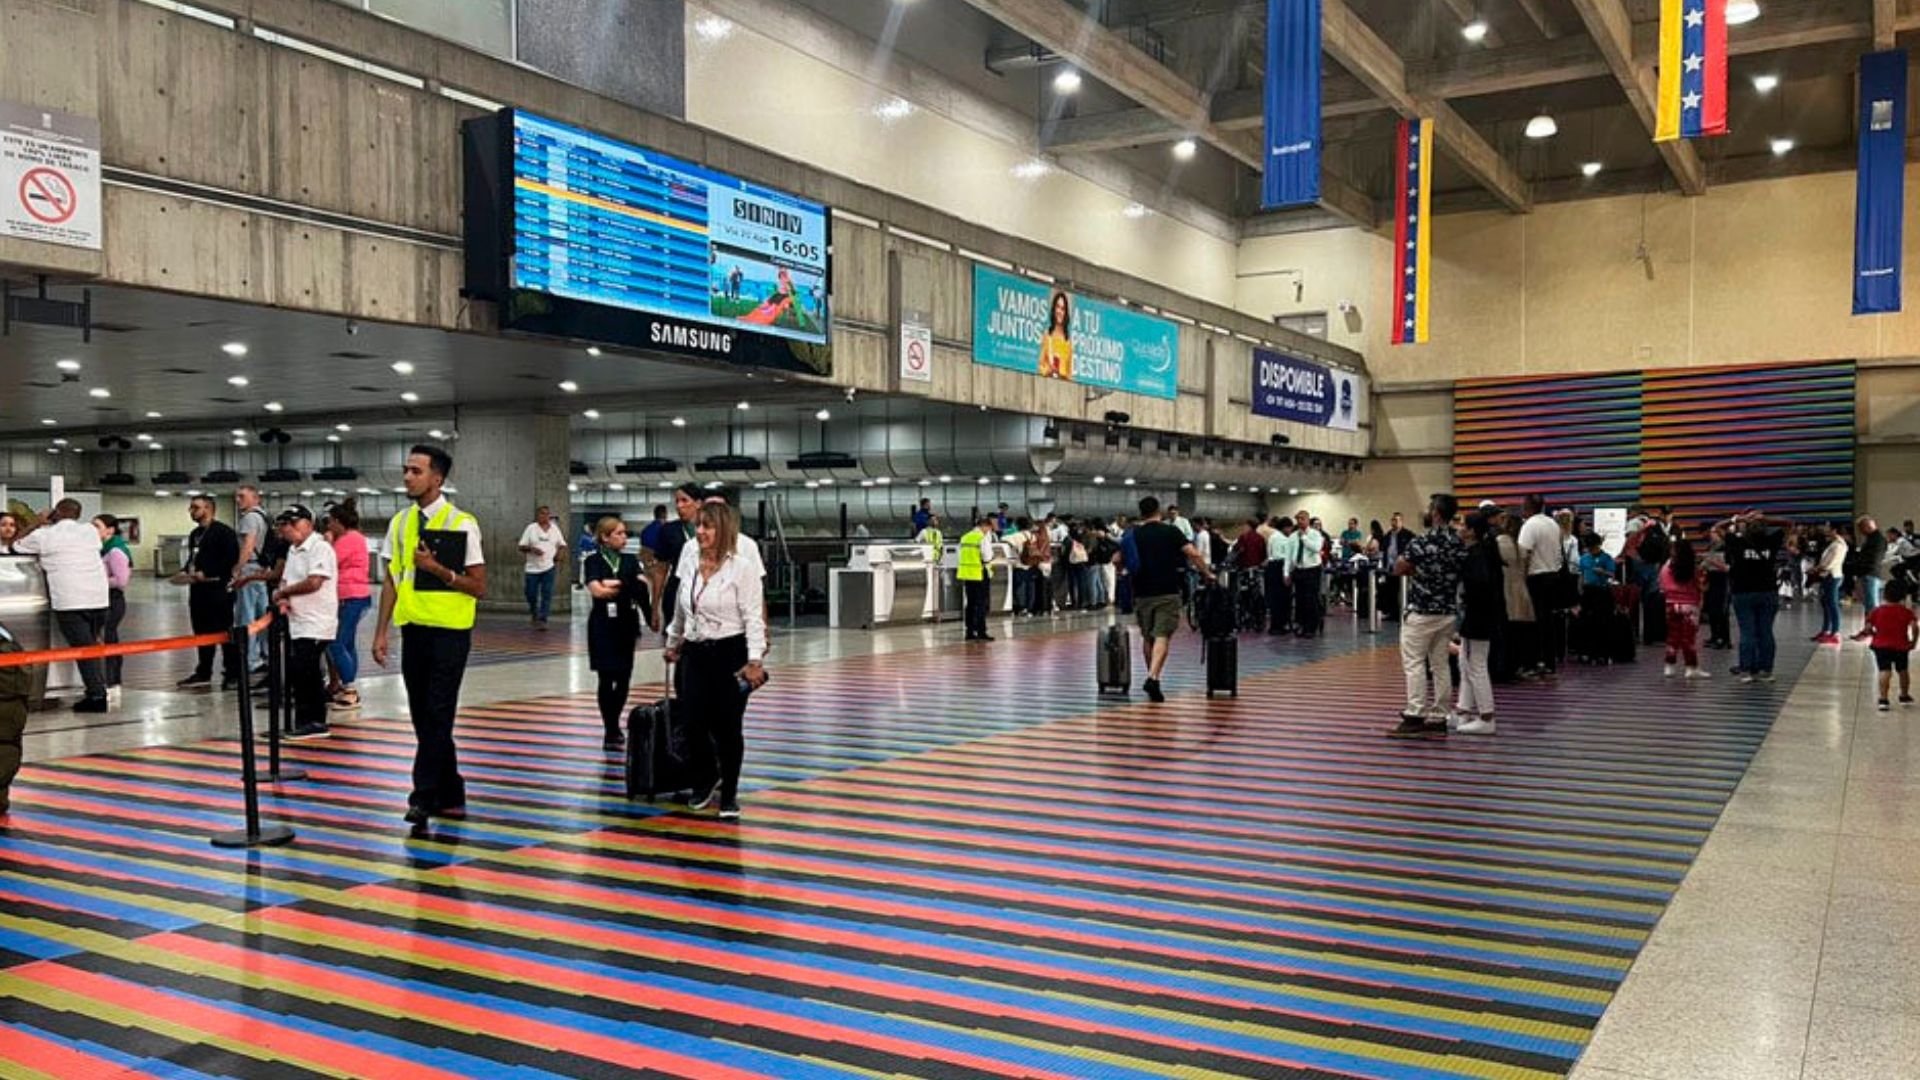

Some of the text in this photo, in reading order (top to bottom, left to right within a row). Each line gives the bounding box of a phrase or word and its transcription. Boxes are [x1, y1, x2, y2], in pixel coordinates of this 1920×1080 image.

[733, 198, 802, 235] SINIV
[771, 235, 819, 262] 16:05
[997, 285, 1049, 322] VAMOS
[1071, 306, 1100, 334] A TU
[651, 322, 732, 353] SAMSUNG
[986, 310, 1043, 345] JUNTOS
[1071, 353, 1122, 385] DESTINO
[1260, 360, 1325, 399] DISPONIBLE
